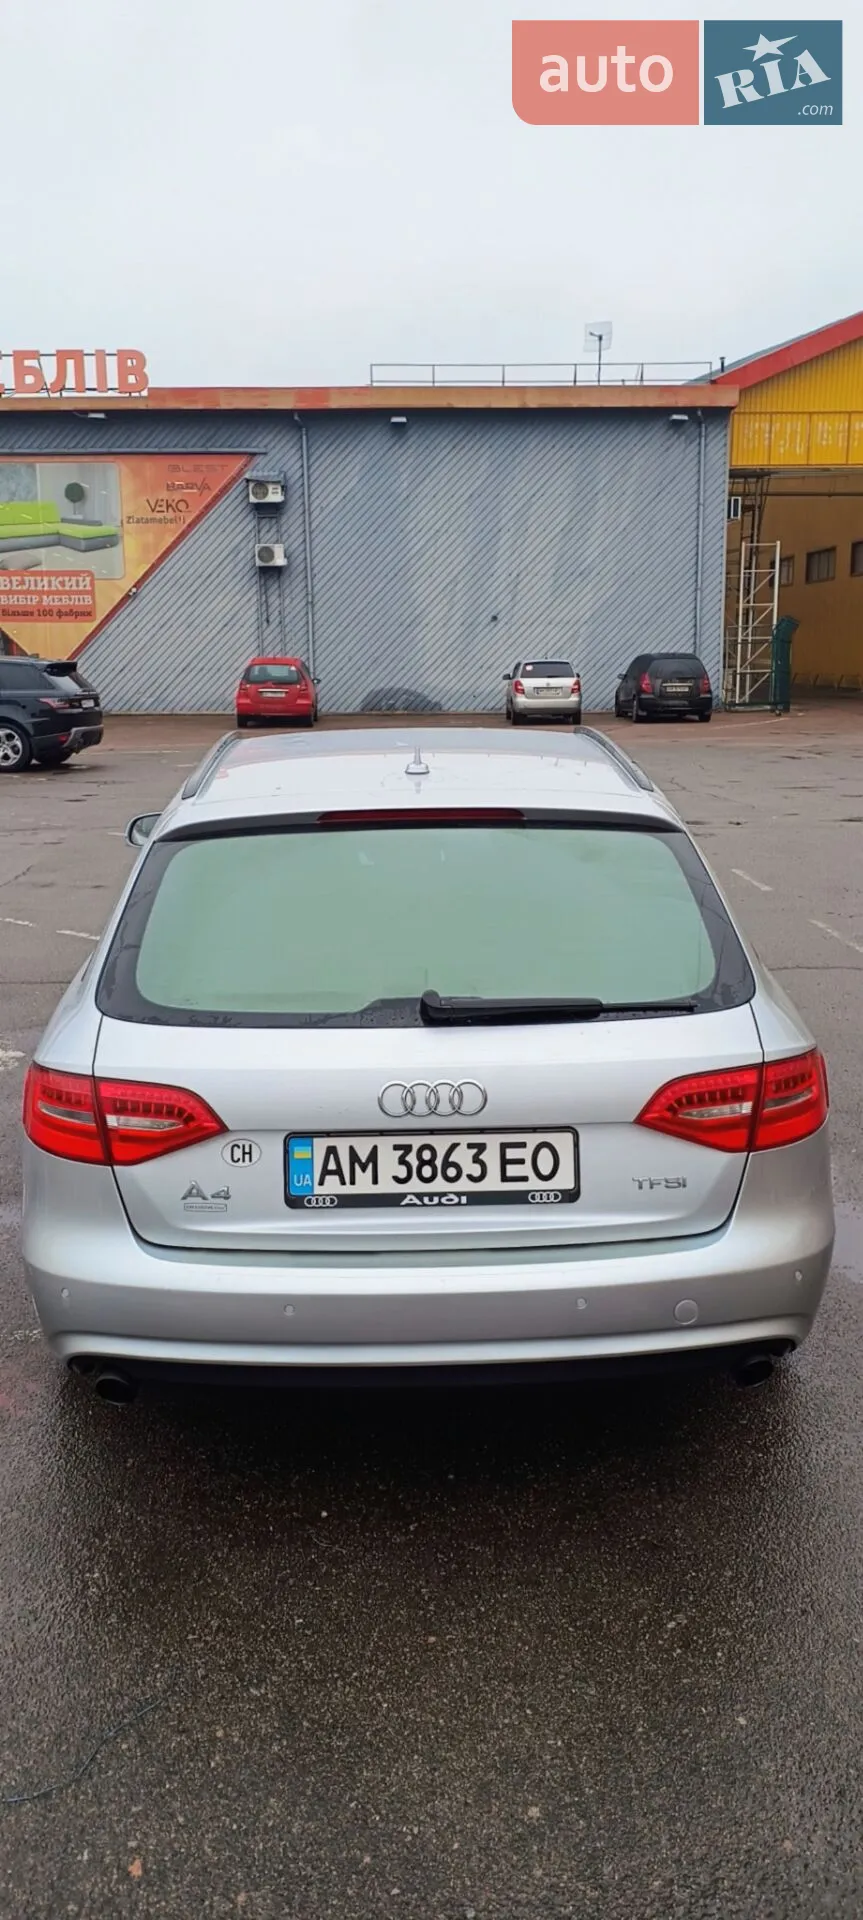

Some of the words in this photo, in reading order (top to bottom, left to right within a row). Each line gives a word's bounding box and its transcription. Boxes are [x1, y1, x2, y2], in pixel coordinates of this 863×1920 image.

[0, 349, 149, 394] БЛІВ
[0, 573, 92, 590] ВЕЛИКИЙ
[0, 594, 39, 605] ВИБІР
[42, 594, 92, 606] МЕБЛІВ
[37, 608, 54, 617] 100
[55, 608, 92, 619] фабрик
[230, 1143, 252, 1163] CH
[317, 1144, 379, 1186] AM
[391, 1142, 488, 1184] 3863
[499, 1140, 560, 1182] EO
[293, 1174, 312, 1187] UA
[631, 1176, 687, 1190] TFSI
[181, 1179, 231, 1200] A4
[400, 1193, 467, 1206] Audi
